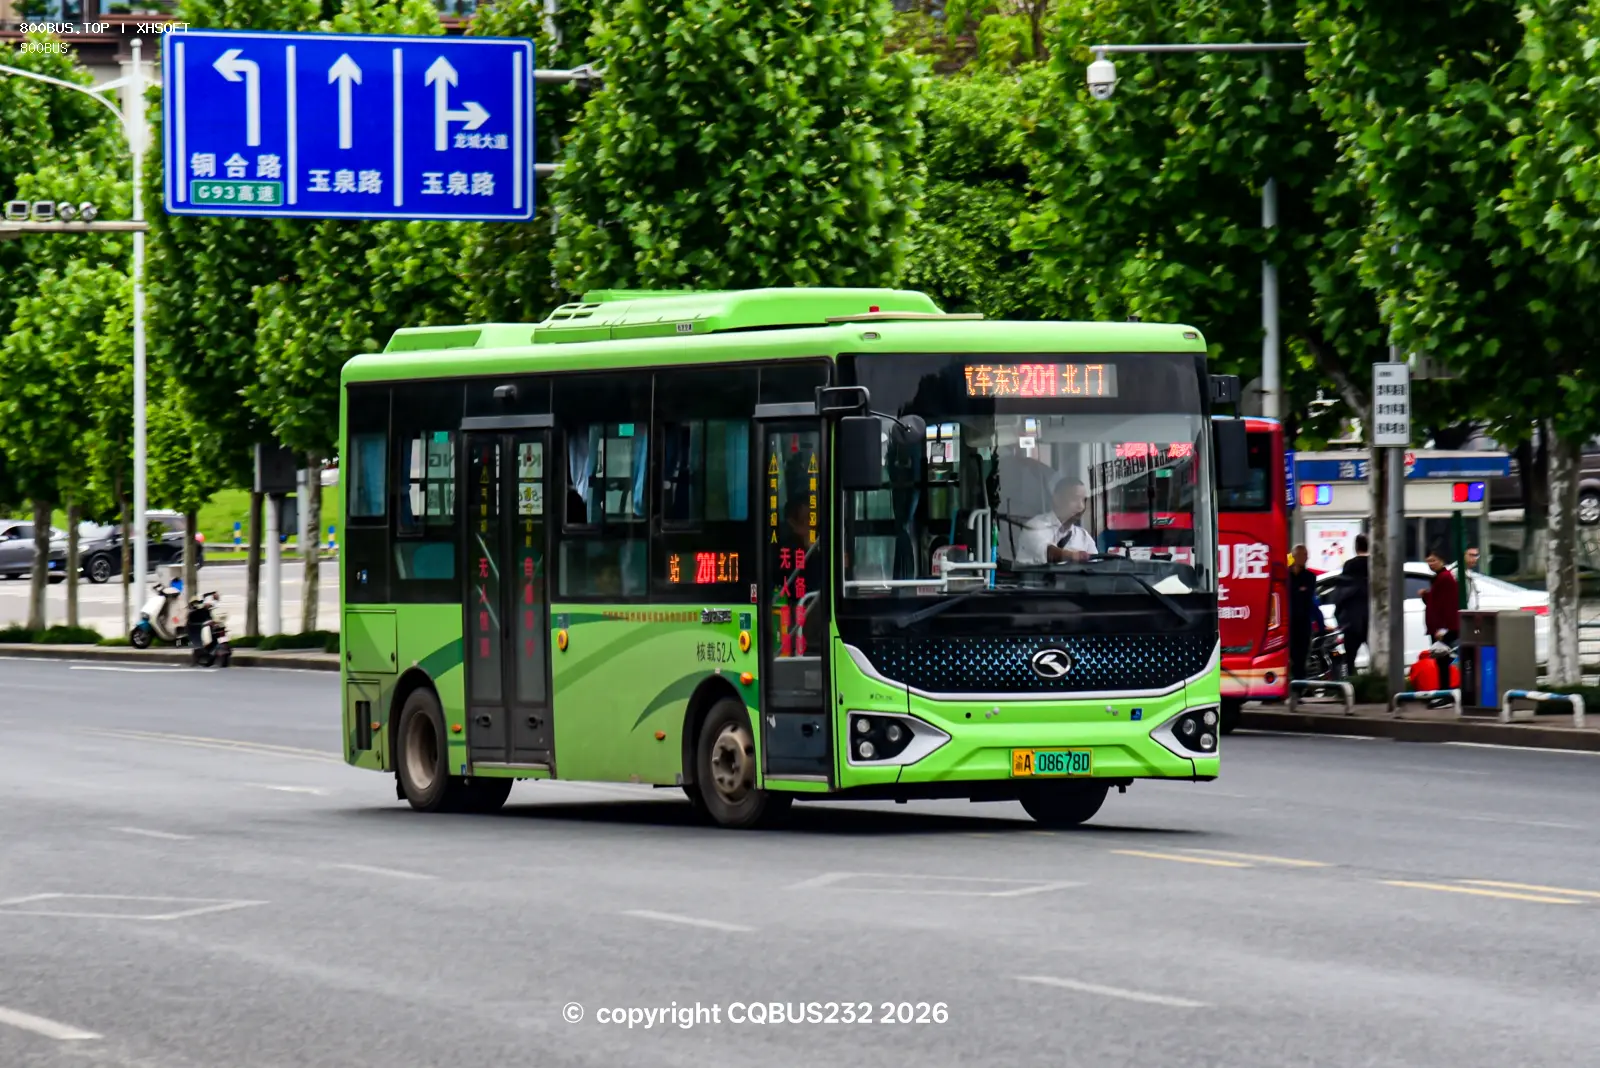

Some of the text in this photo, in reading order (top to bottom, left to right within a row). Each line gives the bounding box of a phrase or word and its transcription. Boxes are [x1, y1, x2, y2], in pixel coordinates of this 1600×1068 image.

[453, 132, 509, 150] 龙城大道
[190, 152, 282, 178] 铜合路
[197, 184, 276, 202] G93高速
[306, 169, 384, 194] 玉泉路
[420, 170, 496, 196] 玉泉路
[1020, 363, 1057, 396] 201
[696, 552, 716, 584] 201
[697, 640, 736, 663] 核载52人
